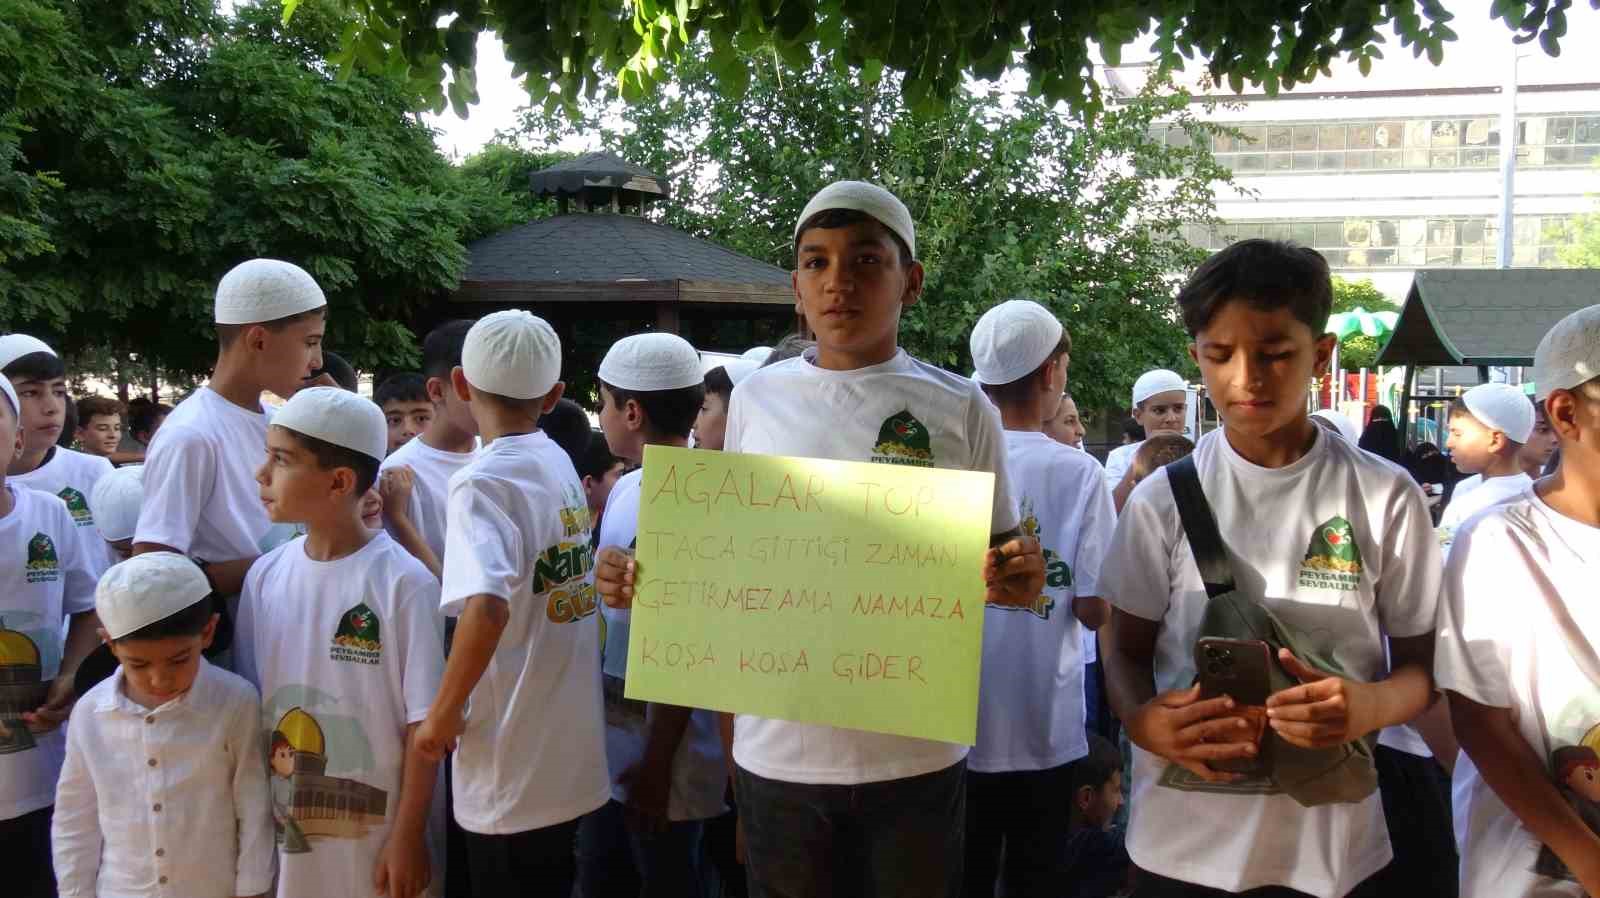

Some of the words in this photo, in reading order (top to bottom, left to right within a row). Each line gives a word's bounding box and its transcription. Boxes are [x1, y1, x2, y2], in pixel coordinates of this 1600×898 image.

[650, 462, 825, 516] AĞALAR
[856, 482, 935, 517] TOP
[646, 530, 737, 561] TACA
[864, 543, 960, 568] ZAMAN
[777, 588, 833, 614] AMA
[852, 592, 965, 623] NAMAZA
[641, 636, 718, 672] KOŞA
[740, 647, 809, 676] KOŞA
[833, 650, 928, 686] GİDER
